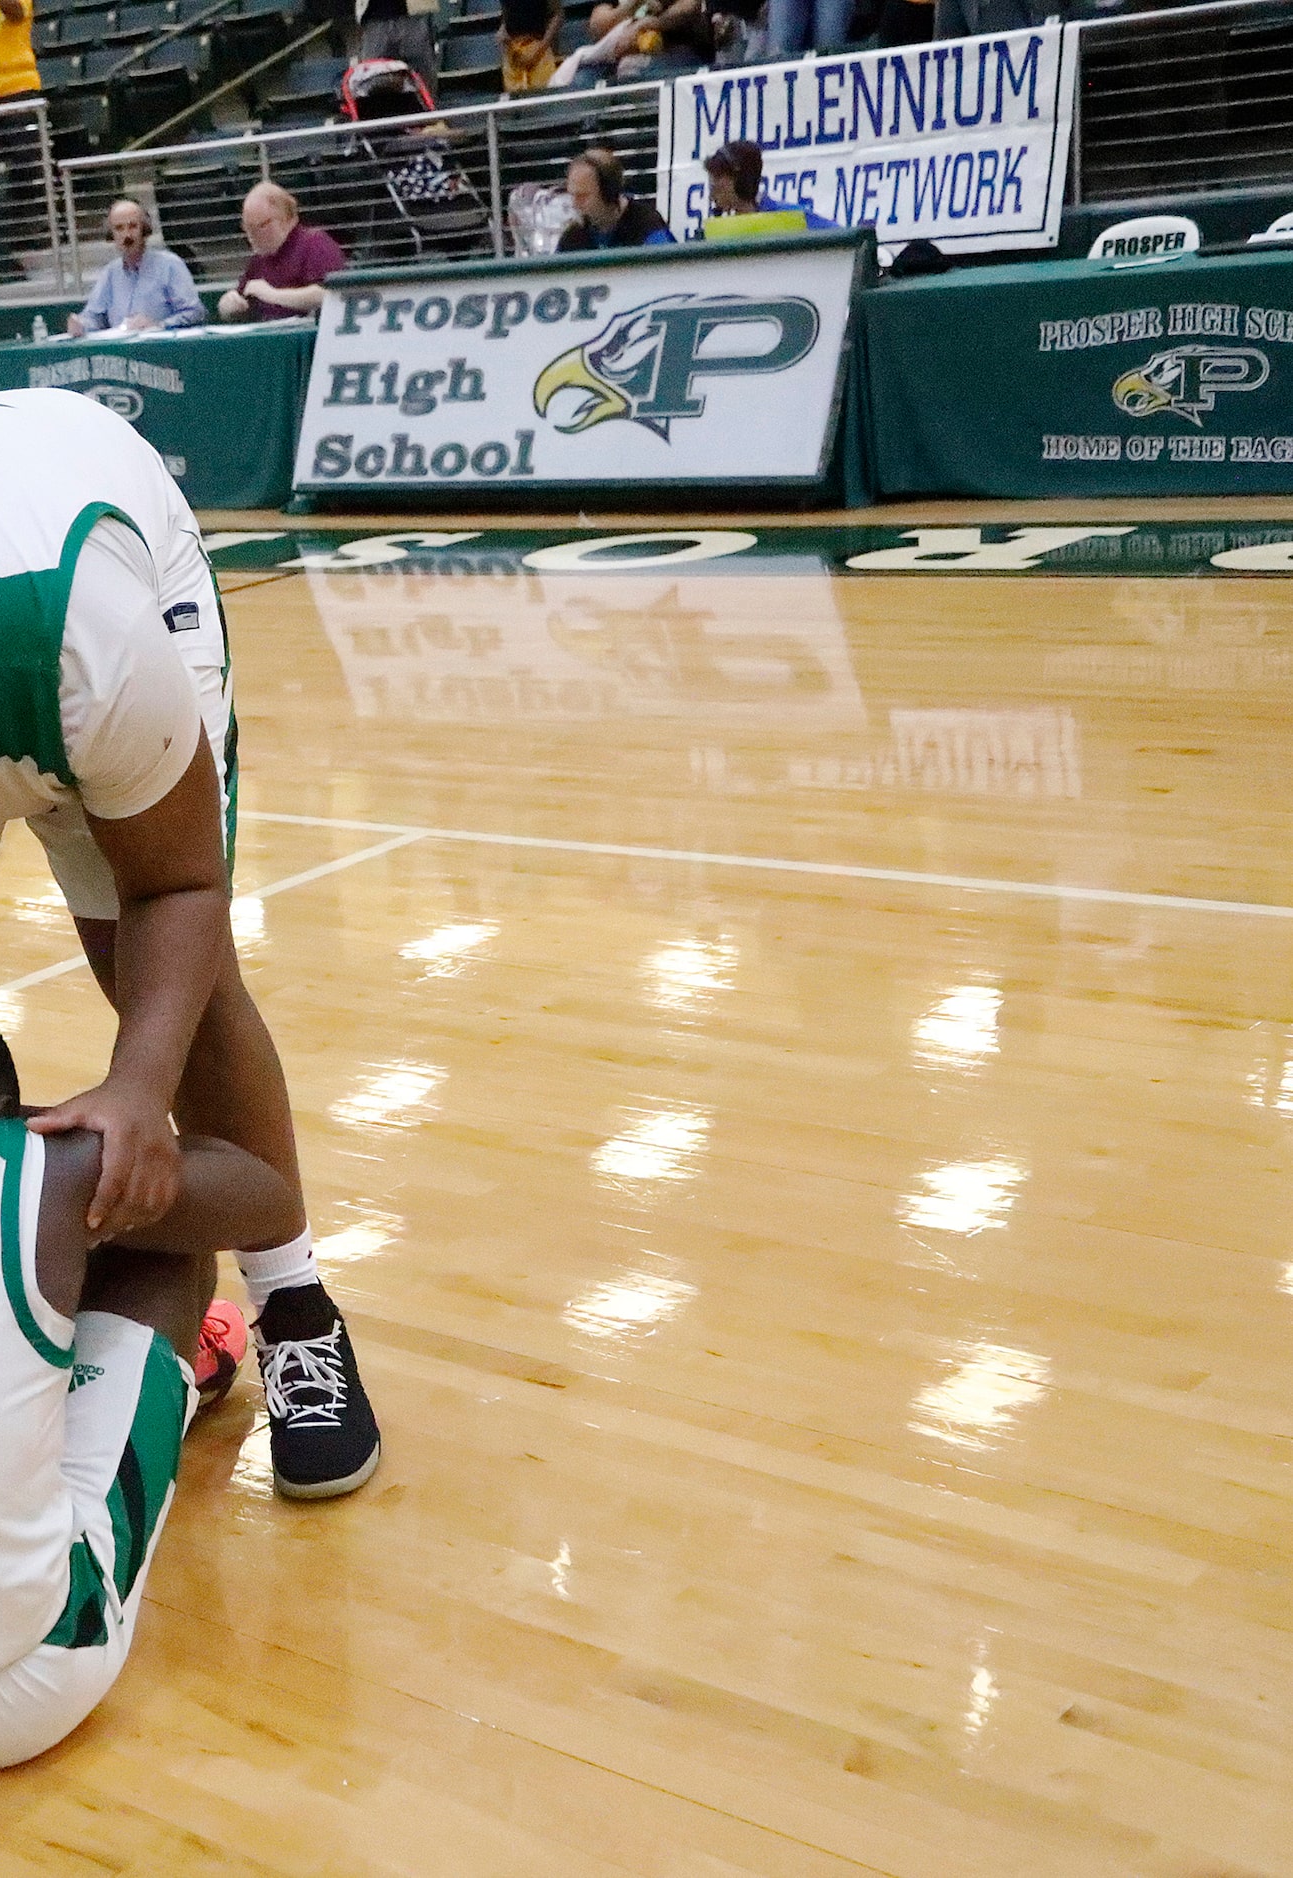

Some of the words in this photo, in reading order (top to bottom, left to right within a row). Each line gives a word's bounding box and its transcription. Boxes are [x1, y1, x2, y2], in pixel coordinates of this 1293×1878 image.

[692, 36, 1043, 159] MILLENNIUM
[834, 146, 1028, 231] NETWORK
[1102, 231, 1187, 257] PROSPER
[334, 284, 611, 340] Prosper
[1039, 307, 1164, 351] PROSPER
[1167, 303, 1240, 337] HIGH
[322, 357, 487, 416] High
[311, 429, 536, 479] School
[1042, 436, 1121, 460] HOME
[1125, 436, 1165, 461] OF
[1167, 436, 1226, 461] THE
